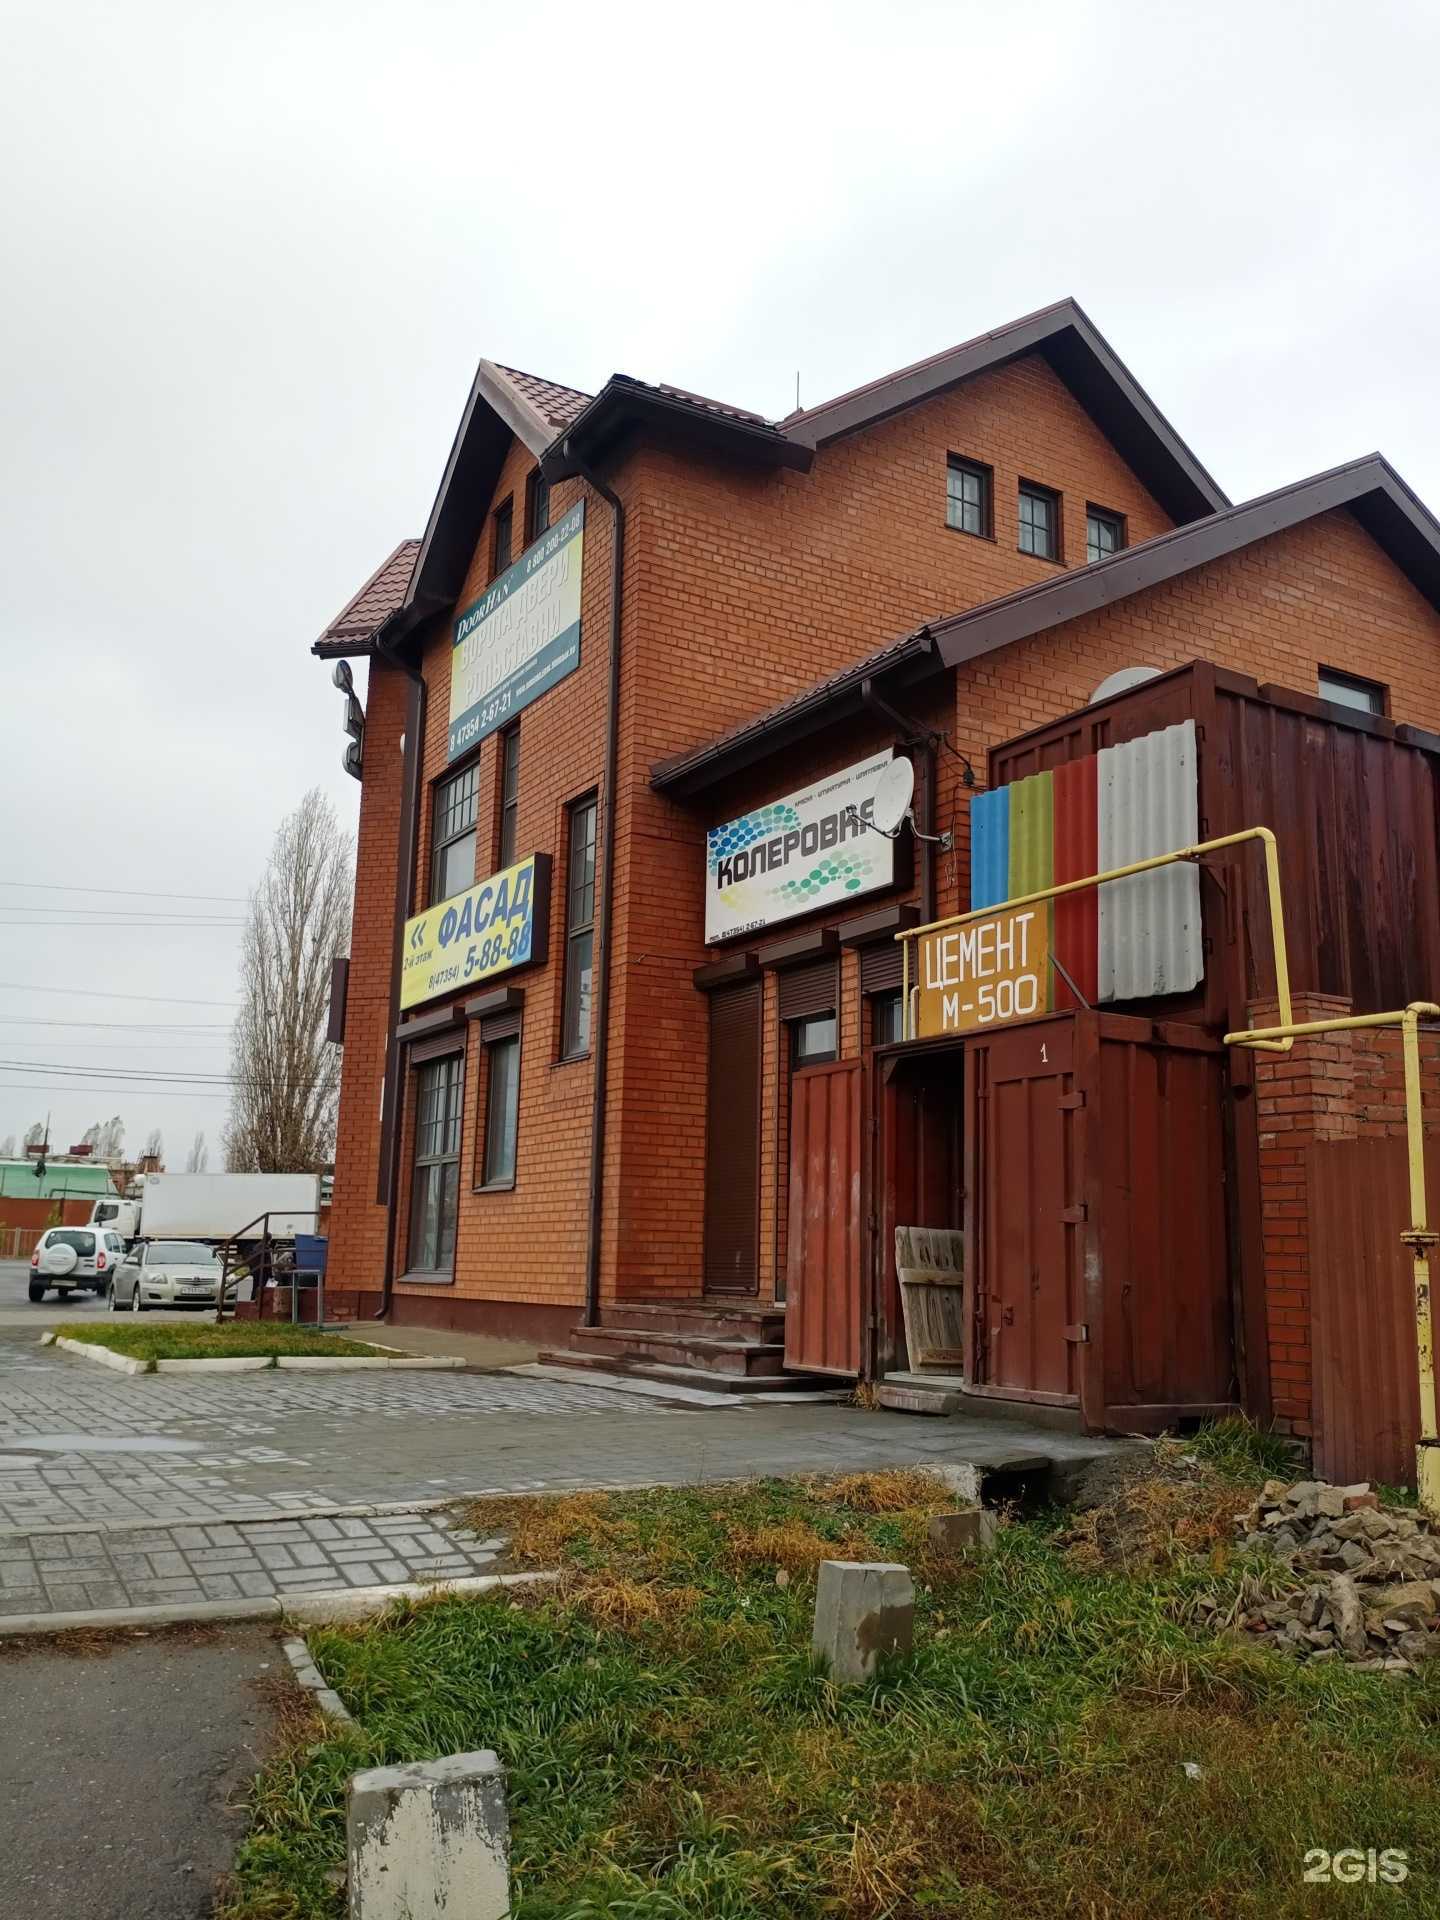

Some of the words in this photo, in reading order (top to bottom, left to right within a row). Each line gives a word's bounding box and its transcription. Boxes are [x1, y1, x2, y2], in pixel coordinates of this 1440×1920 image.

[449, 734, 456, 753] 8
[480, 690, 512, 729] 2-67-21
[438, 864, 533, 949] ФАСАД
[463, 920, 531, 978] 5-88-88
[925, 911, 1035, 990] ЦЕМЕНТ
[1040, 1043, 1048, 1063] 1
